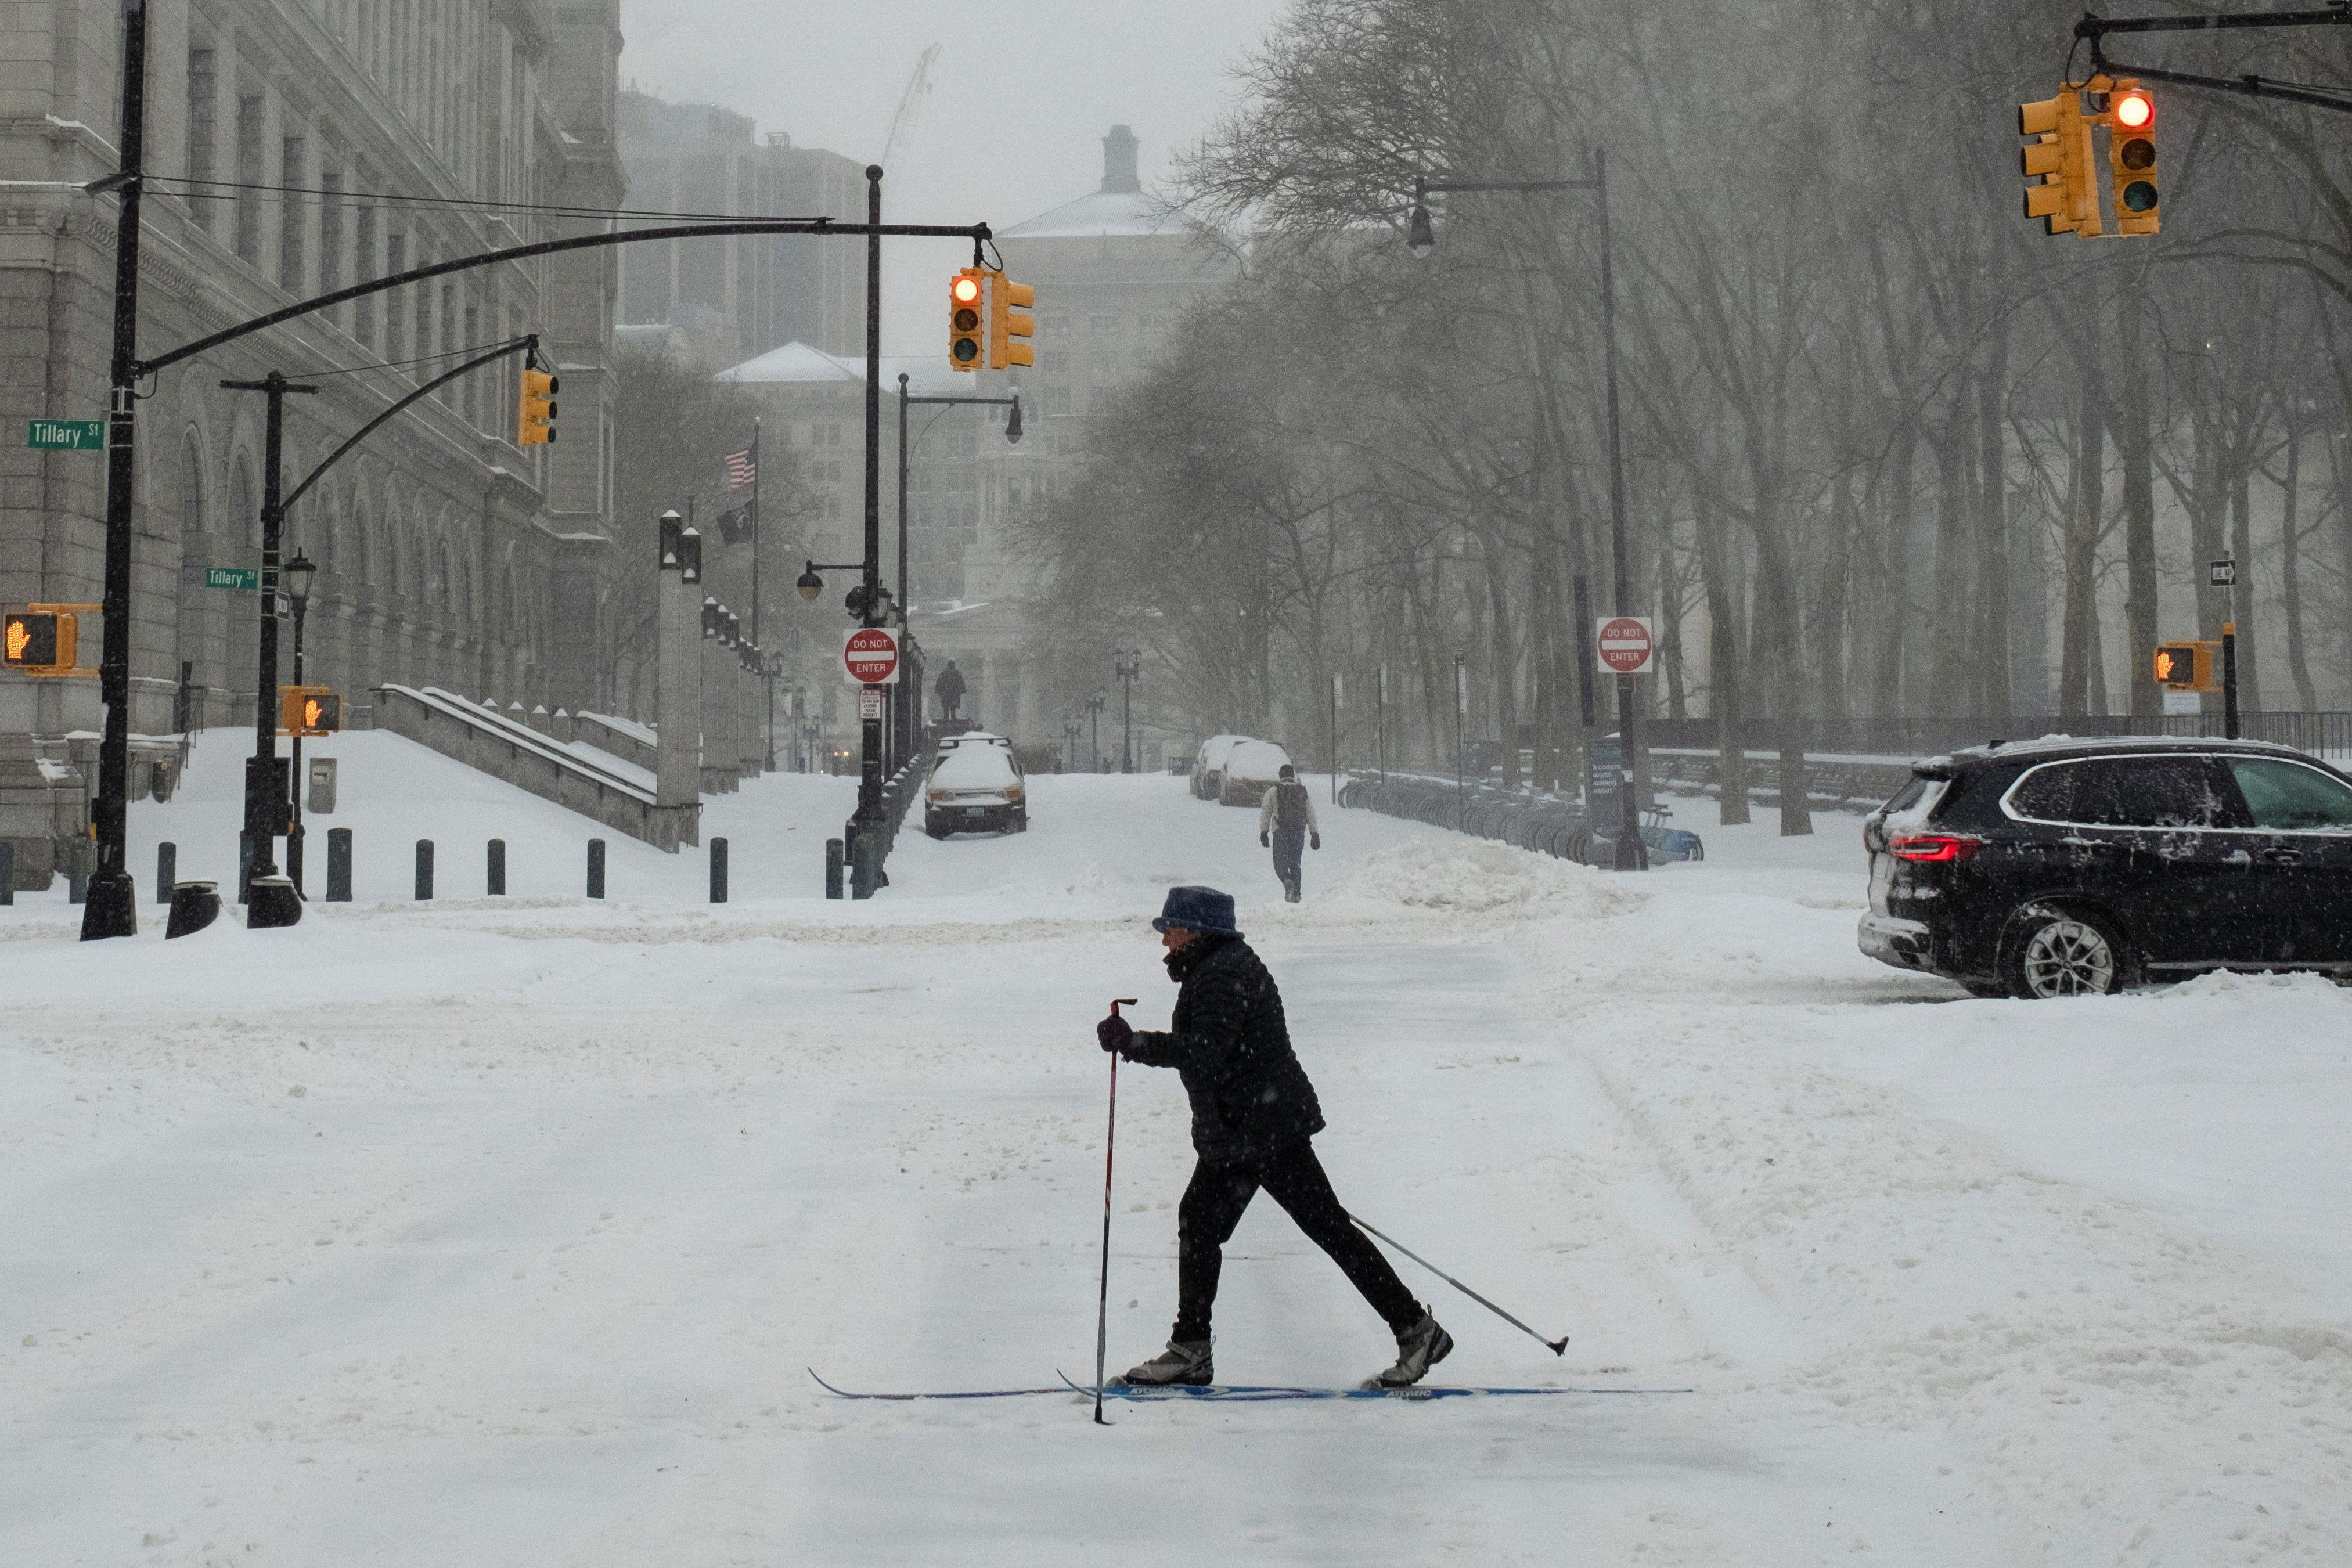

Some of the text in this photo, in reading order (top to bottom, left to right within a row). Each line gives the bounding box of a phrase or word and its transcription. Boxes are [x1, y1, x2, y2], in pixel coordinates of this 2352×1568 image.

[34, 423, 99, 448] Tillary St
[210, 570, 255, 588] Tillary St
[1607, 629, 1641, 637] DO NOT
[853, 639, 888, 648] DO NOT
[1610, 652, 1640, 661] ENTER
[856, 664, 886, 672] ENTER
